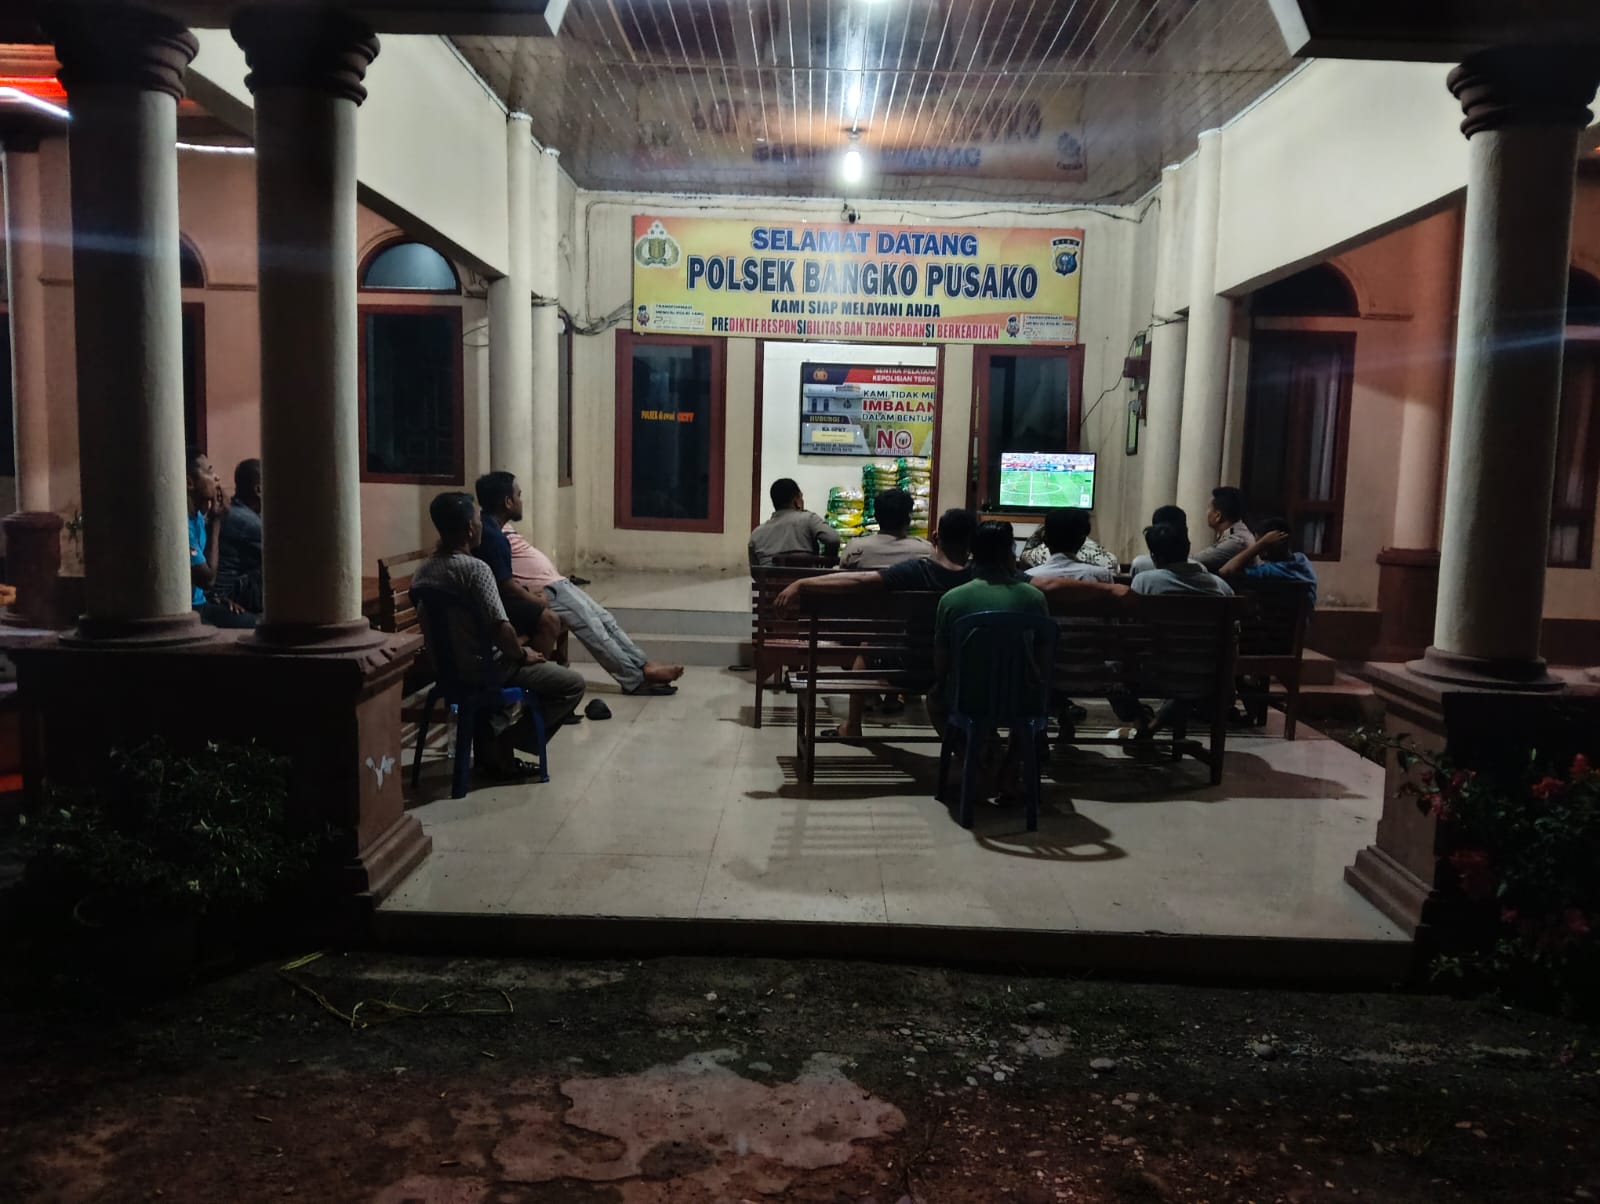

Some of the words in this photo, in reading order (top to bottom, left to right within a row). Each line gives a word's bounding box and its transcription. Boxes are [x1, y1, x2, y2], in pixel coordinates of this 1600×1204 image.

[752, 228, 870, 254] SELAMAT
[876, 231, 978, 257] DATANG
[687, 255, 796, 293] POLSEK
[803, 258, 918, 297] BANGKO
[925, 262, 1038, 300] PUSAKO
[771, 299, 804, 314] KAMI
[808, 300, 838, 315] SIAP
[841, 301, 903, 317] MELAYANI
[905, 303, 941, 318] ANDA
[843, 320, 863, 336] DAN
[865, 321, 935, 338] TRANSPARANSI
[936, 324, 1000, 340] BERKEADILAN
[872, 375, 912, 383] KEPOLISIAN
[863, 390, 888, 398] KAMI
[890, 390, 918, 398] TIDAK
[862, 400, 935, 412] IMBALAN
[862, 413, 894, 421] DALAM
[897, 414, 933, 422] BENTUK
[876, 430, 912, 449] NO
